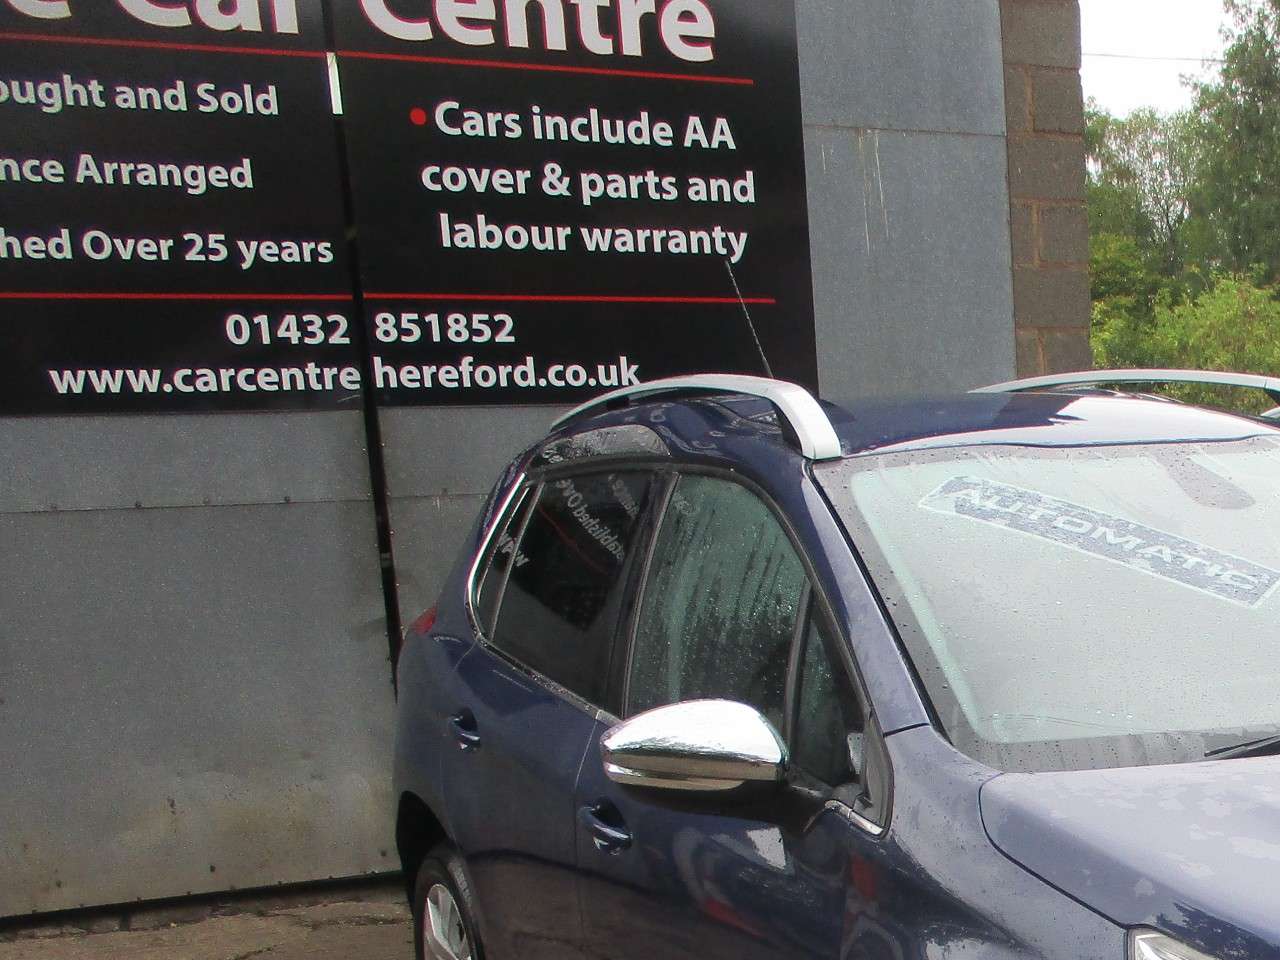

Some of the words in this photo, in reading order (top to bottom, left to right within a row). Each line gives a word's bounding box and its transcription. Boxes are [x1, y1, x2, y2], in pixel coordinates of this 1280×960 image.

[114, 80, 188, 112] and
[198, 83, 279, 115] Sold
[434, 101, 522, 139] Cars
[532, 105, 674, 147] include
[683, 115, 737, 150] AA
[76, 154, 254, 195] Arranged
[421, 165, 531, 195] cover
[541, 162, 571, 196] &
[580, 170, 678, 206] parts
[687, 170, 756, 203] and
[82, 230, 174, 261] Over
[183, 233, 228, 261] 25
[237, 239, 334, 270] years
[440, 213, 571, 251] labour
[580, 226, 748, 264] warranty
[225, 314, 350, 345] 01432
[375, 313, 515, 343] 851852
[951, 488, 1263, 590] AUTOMATIC
